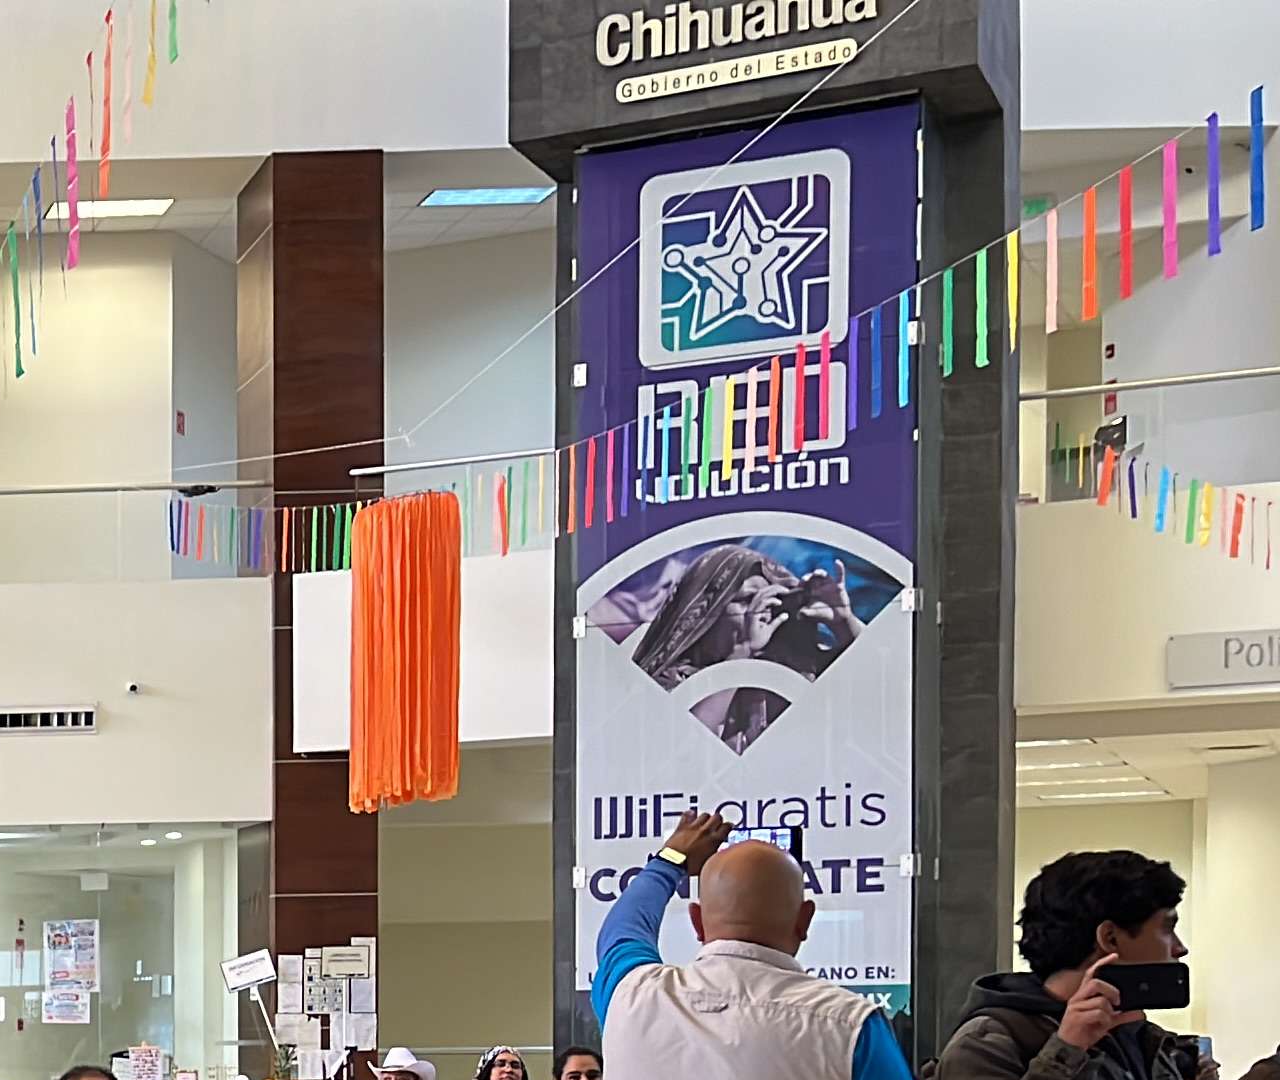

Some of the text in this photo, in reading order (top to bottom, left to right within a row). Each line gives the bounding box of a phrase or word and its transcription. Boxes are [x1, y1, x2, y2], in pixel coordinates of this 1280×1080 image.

[596, 0, 877, 67] Chihuahua
[621, 45, 852, 99] Gobierno del Estado
[1224, 636, 1280, 669] Pol
[865, 966, 896, 979] EN:
